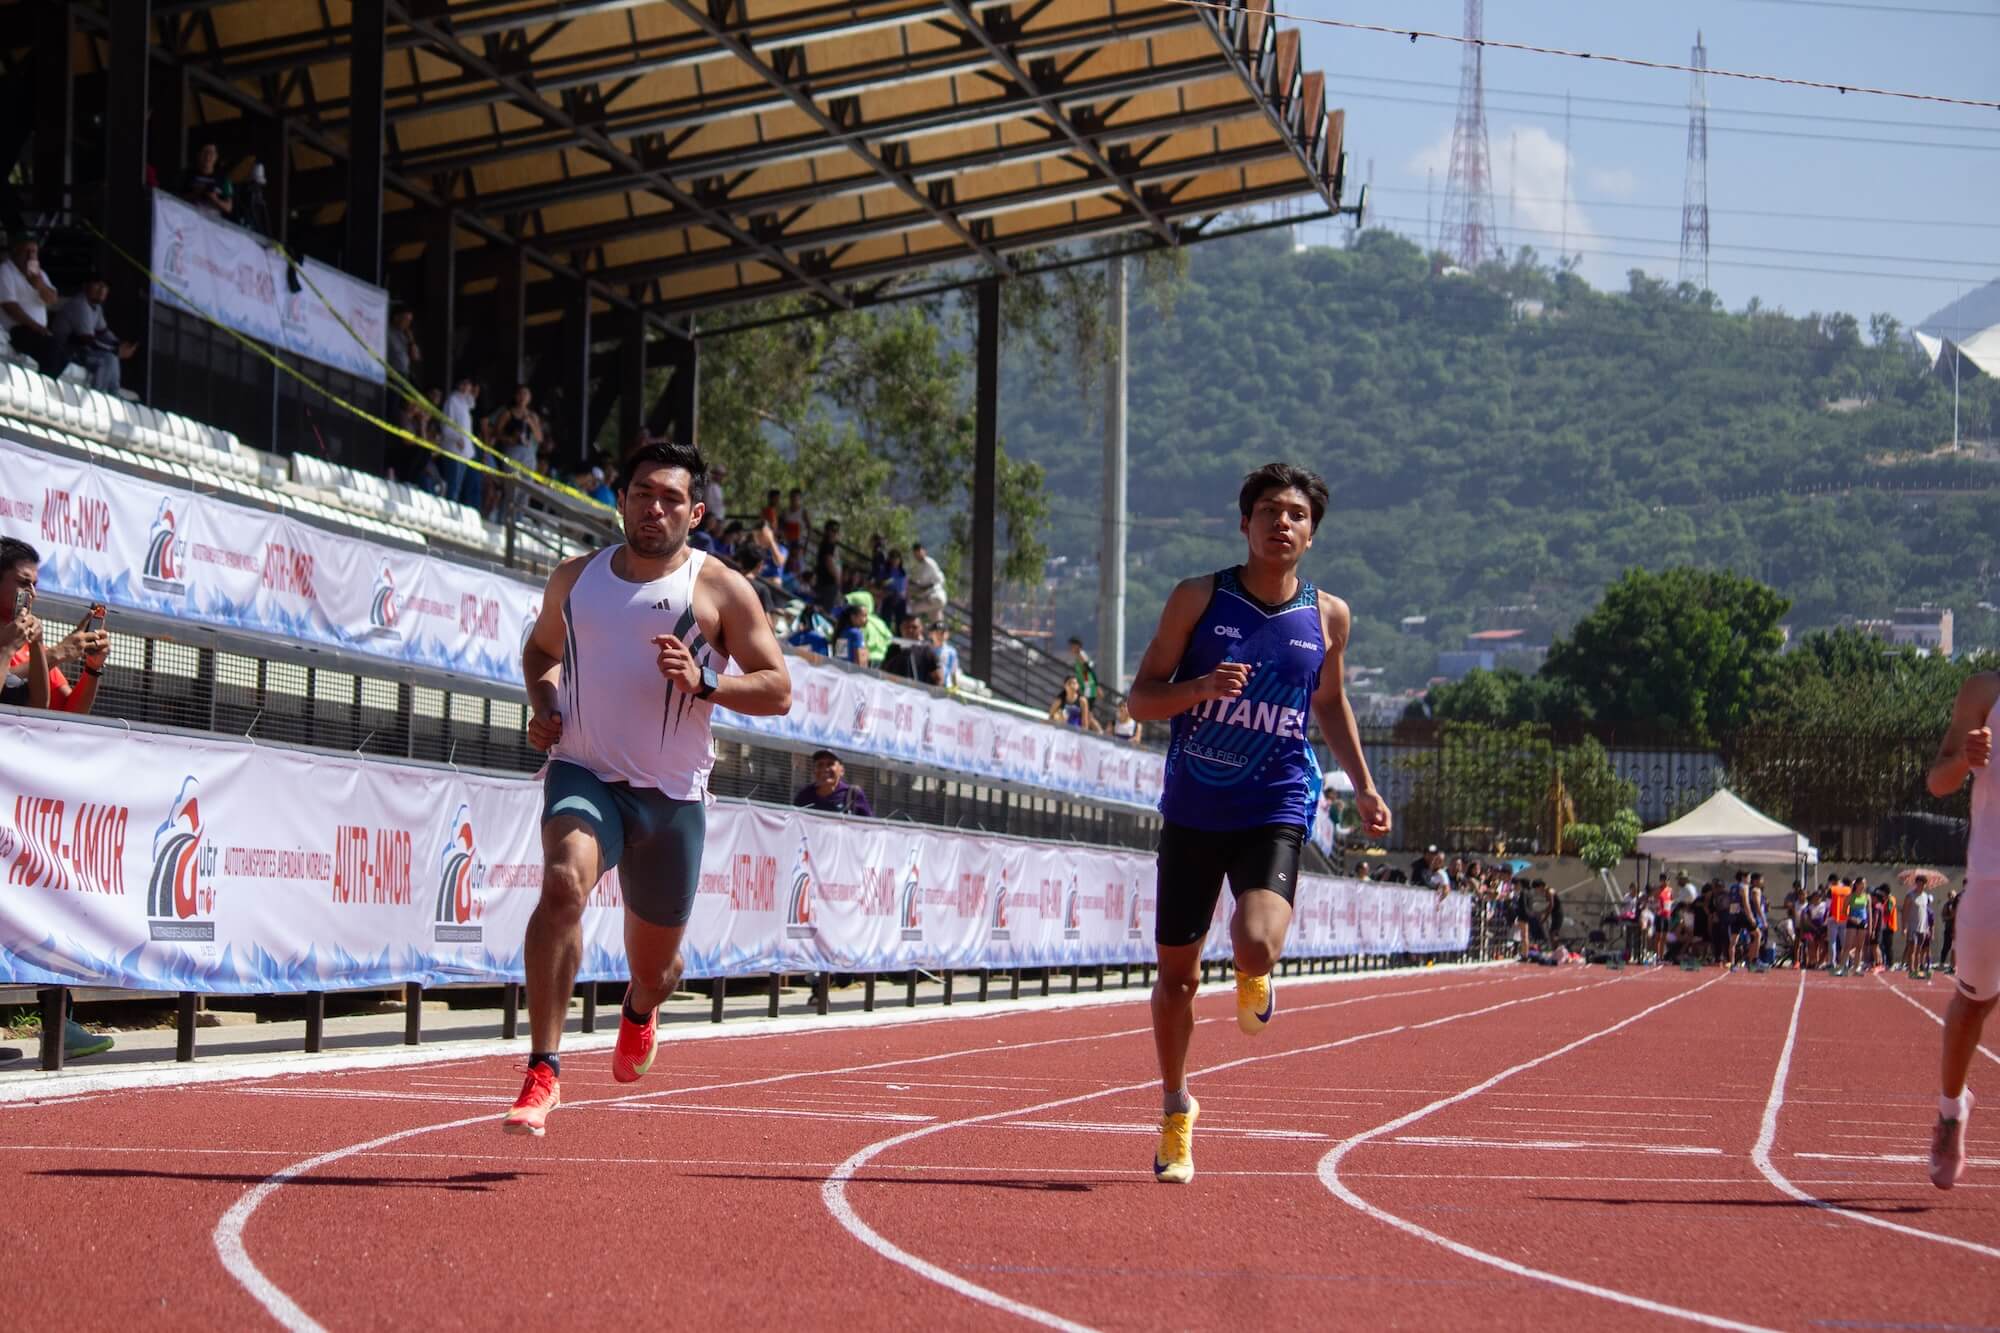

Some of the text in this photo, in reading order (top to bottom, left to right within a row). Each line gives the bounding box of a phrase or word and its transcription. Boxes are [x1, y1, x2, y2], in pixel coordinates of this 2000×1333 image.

[41, 488, 110, 552] AUTR-AMOR
[1216, 750, 1248, 765] FIELD
[9, 795, 128, 895] AUTR-AMOR
[332, 825, 411, 905] AUTR-AMOR
